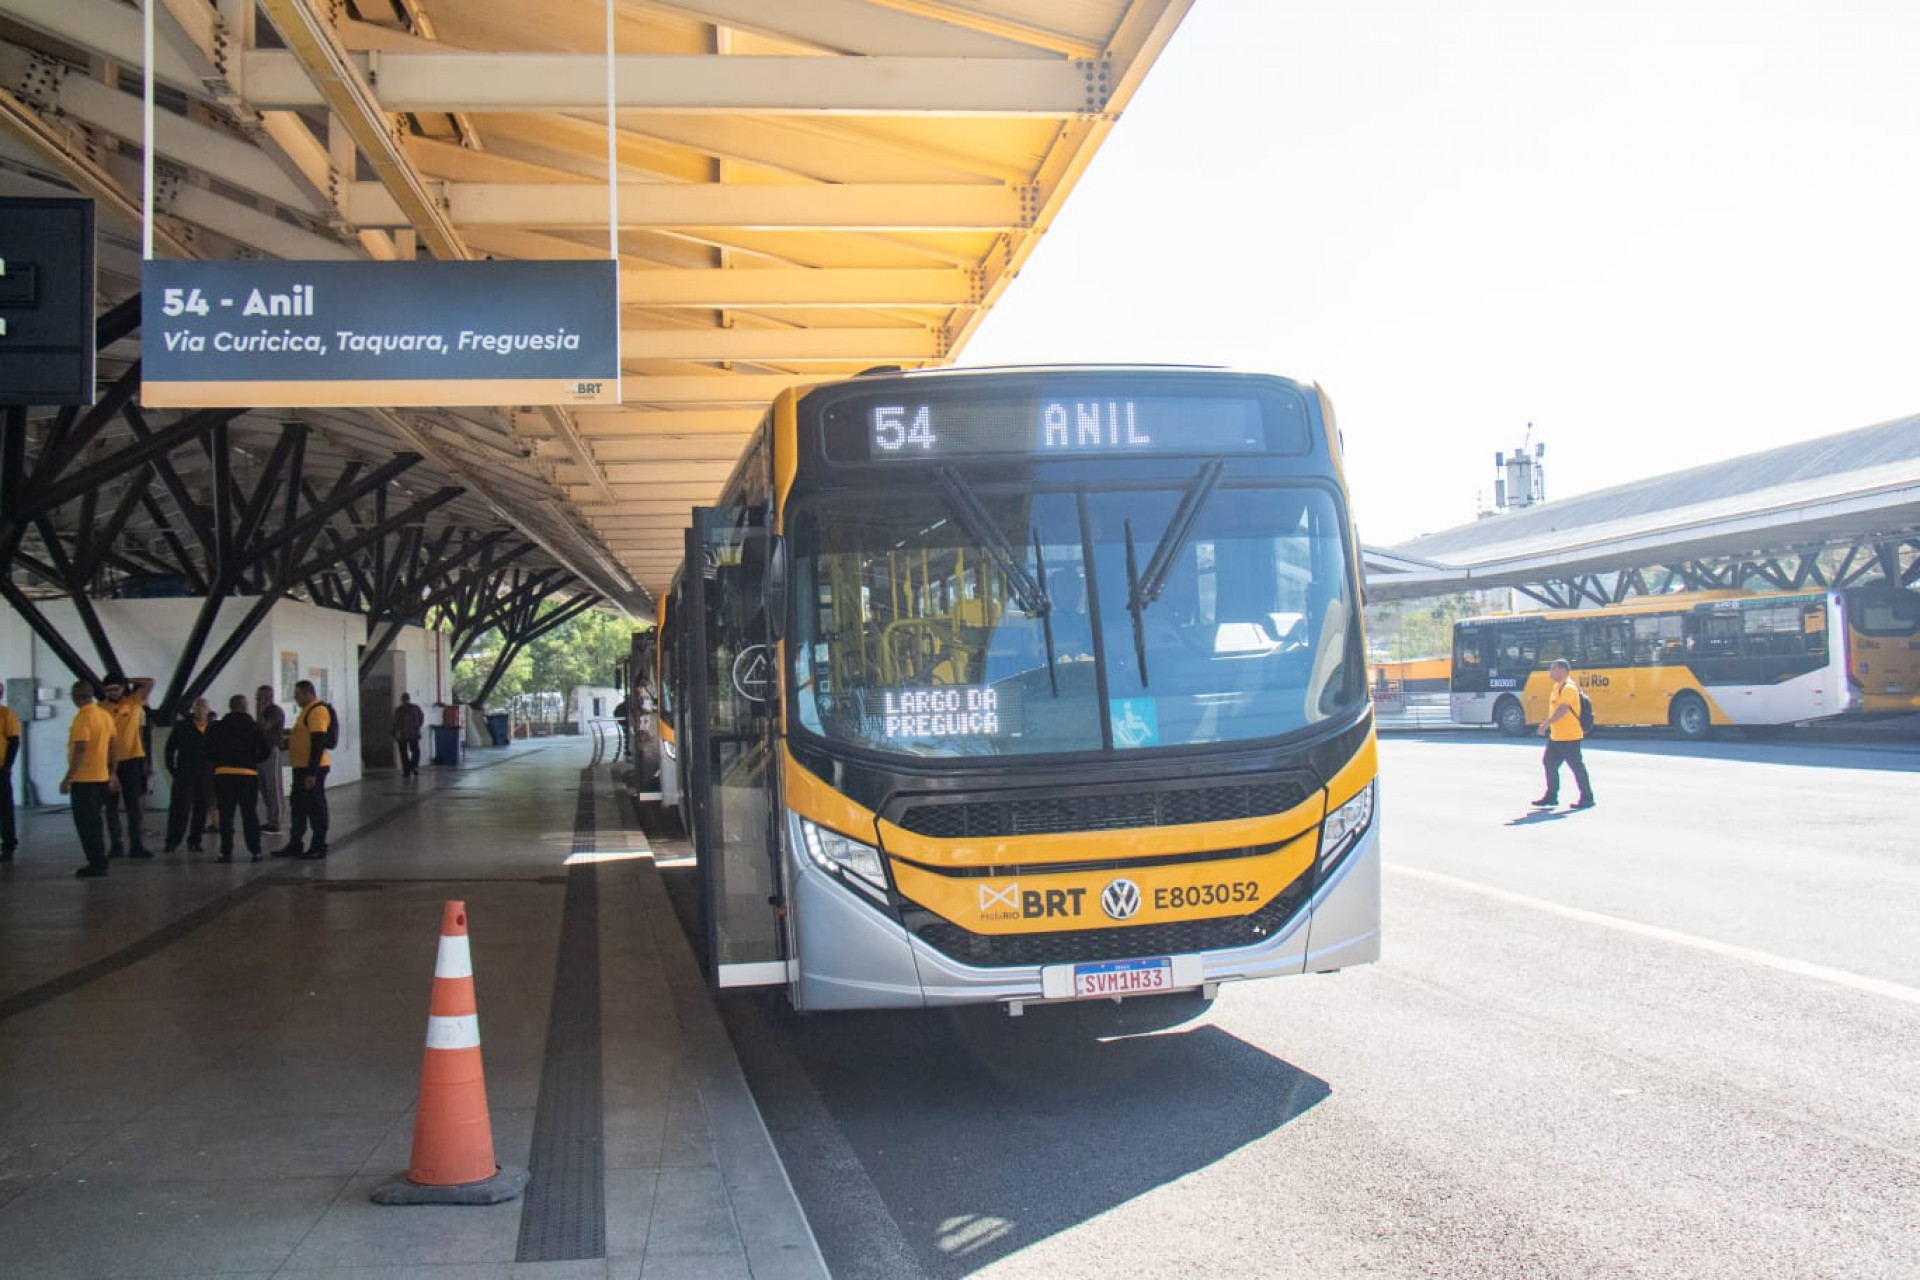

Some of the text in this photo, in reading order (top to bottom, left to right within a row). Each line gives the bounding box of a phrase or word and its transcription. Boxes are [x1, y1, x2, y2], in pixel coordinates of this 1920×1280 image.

[162, 284, 314, 317] 54 - Anil
[163, 328, 580, 356] Via Curicica, Taquara, Freguesia
[577, 382, 602, 394] BRT
[875, 402, 1151, 450] 54 ANIL
[1591, 674, 1610, 687] Rio
[886, 689, 998, 714] LARGO DA
[1022, 888, 1087, 919] BRT
[1154, 882, 1260, 910] E803052
[1085, 969, 1163, 993] SVM1H33
